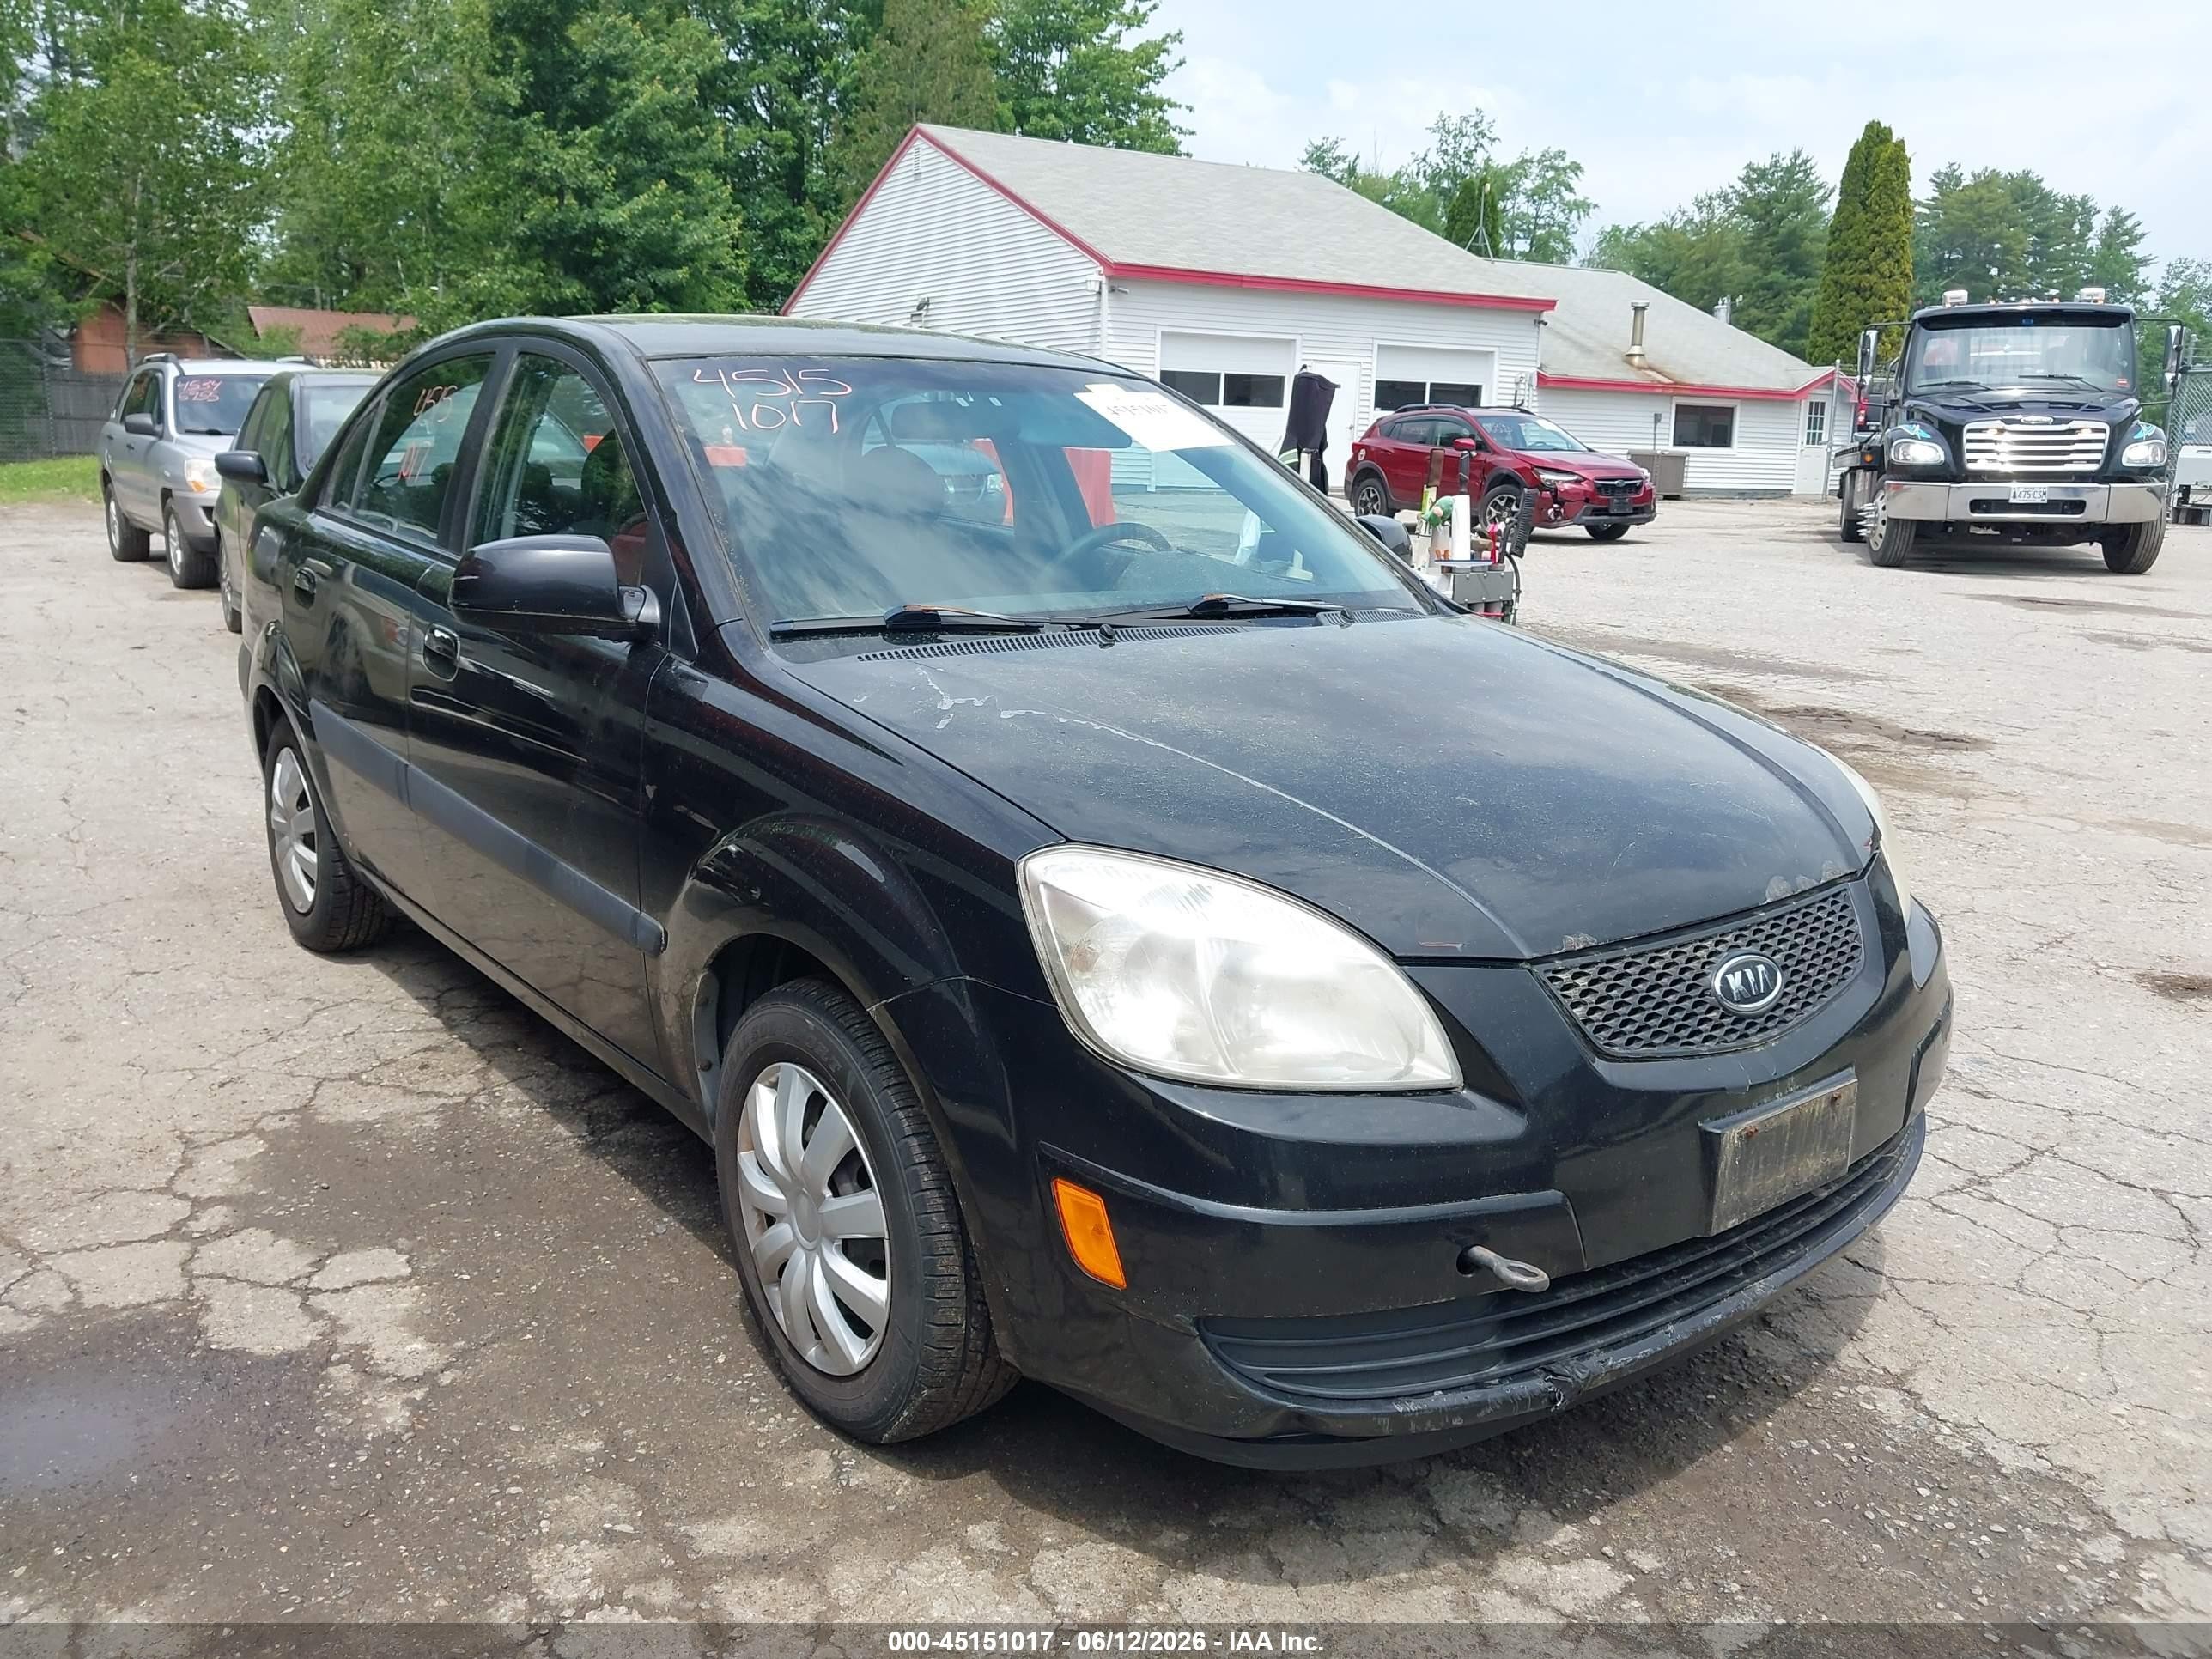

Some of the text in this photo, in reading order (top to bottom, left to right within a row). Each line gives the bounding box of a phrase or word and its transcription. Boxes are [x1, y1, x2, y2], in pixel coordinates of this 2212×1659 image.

[693, 368, 853, 398] 4515
[732, 400, 838, 434] 1017
[1724, 963, 1775, 1002] KIA
